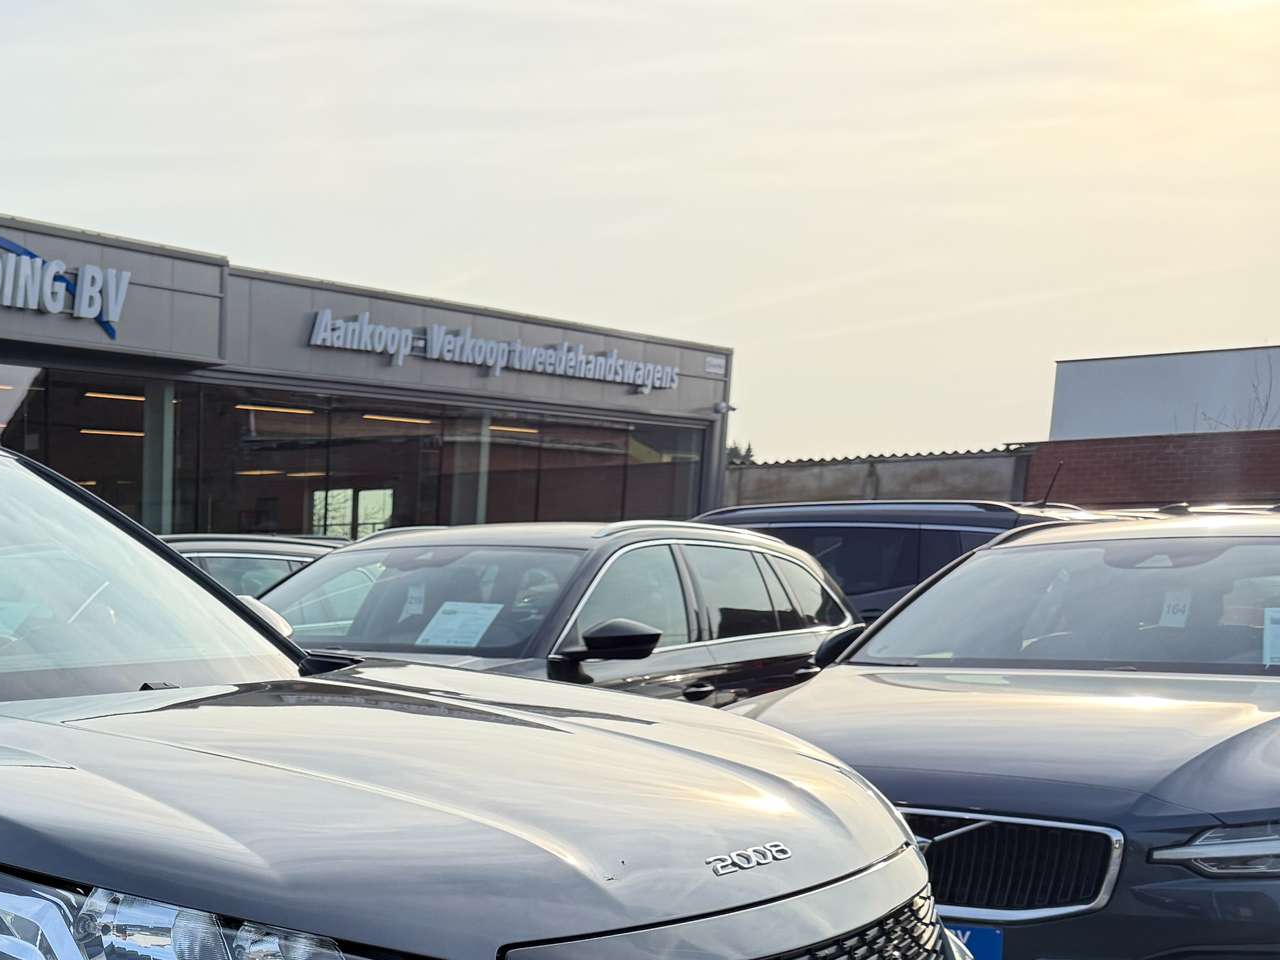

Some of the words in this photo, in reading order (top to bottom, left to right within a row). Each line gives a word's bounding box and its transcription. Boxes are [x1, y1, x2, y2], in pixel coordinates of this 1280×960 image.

[74, 263, 132, 322] BV
[310, 307, 412, 367] Aankoop
[426, 323, 508, 377] Verkoop
[509, 338, 679, 394] tweedehandswagens
[705, 841, 792, 876] 2008
